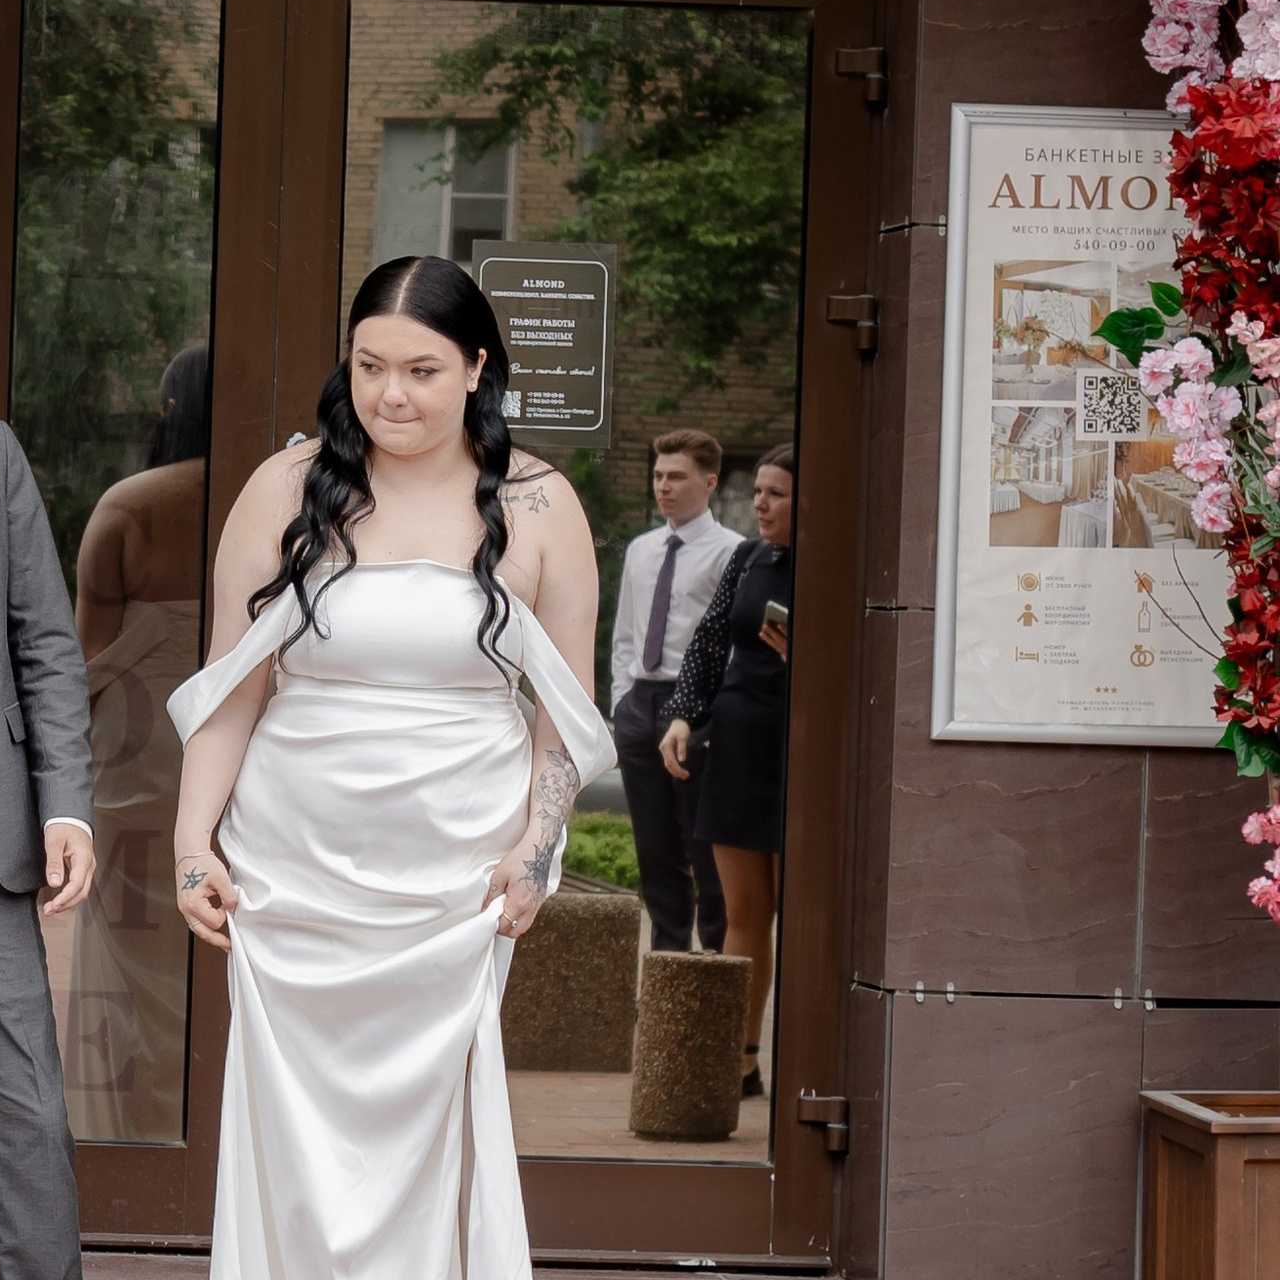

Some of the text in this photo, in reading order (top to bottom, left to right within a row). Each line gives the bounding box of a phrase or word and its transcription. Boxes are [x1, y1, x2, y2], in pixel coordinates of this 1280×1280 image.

[1024, 147, 1143, 164] БАНКЕТНЫЕ
[1012, 225, 1049, 235] МЕСТО
[1053, 226, 1092, 235] ВАШИХ
[1096, 226, 1168, 236] СЧАСТЛИВЫХ
[1073, 239, 1156, 251] 540-09-00
[522, 279, 565, 289] ALMOND
[509, 317, 575, 328] ГРАФИК РАБОТЫ
[510, 330, 573, 341] БЕЗ ВЫХОДНЫХ
